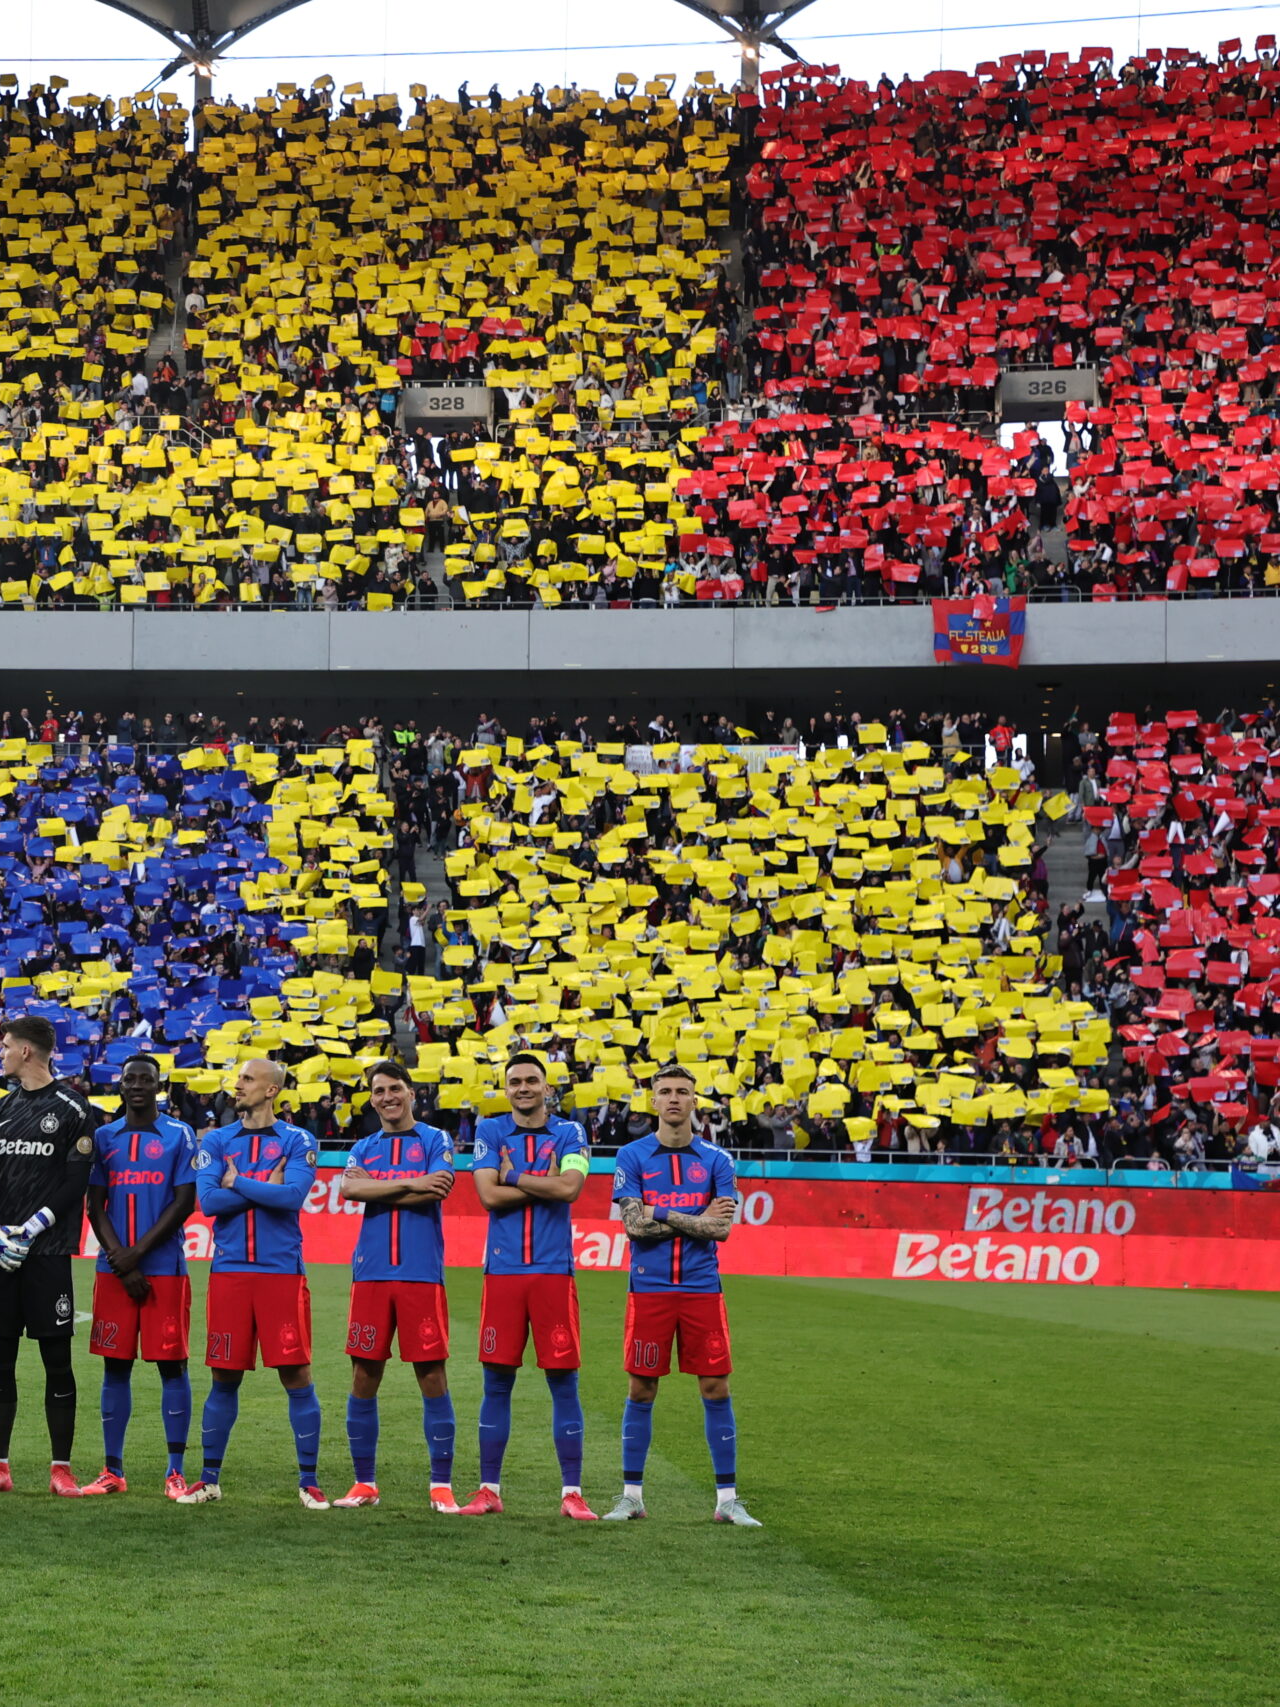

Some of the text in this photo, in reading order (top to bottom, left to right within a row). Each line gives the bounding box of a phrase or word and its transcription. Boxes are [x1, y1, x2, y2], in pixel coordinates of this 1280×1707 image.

[1028, 381, 1066, 395] 326
[429, 397, 464, 410] 328
[964, 1188, 1136, 1235] Betano
[892, 1233, 1100, 1282] Betano
[209, 1332, 231, 1360] 21
[348, 1321, 377, 1351] 33
[634, 1338, 659, 1368] 10
